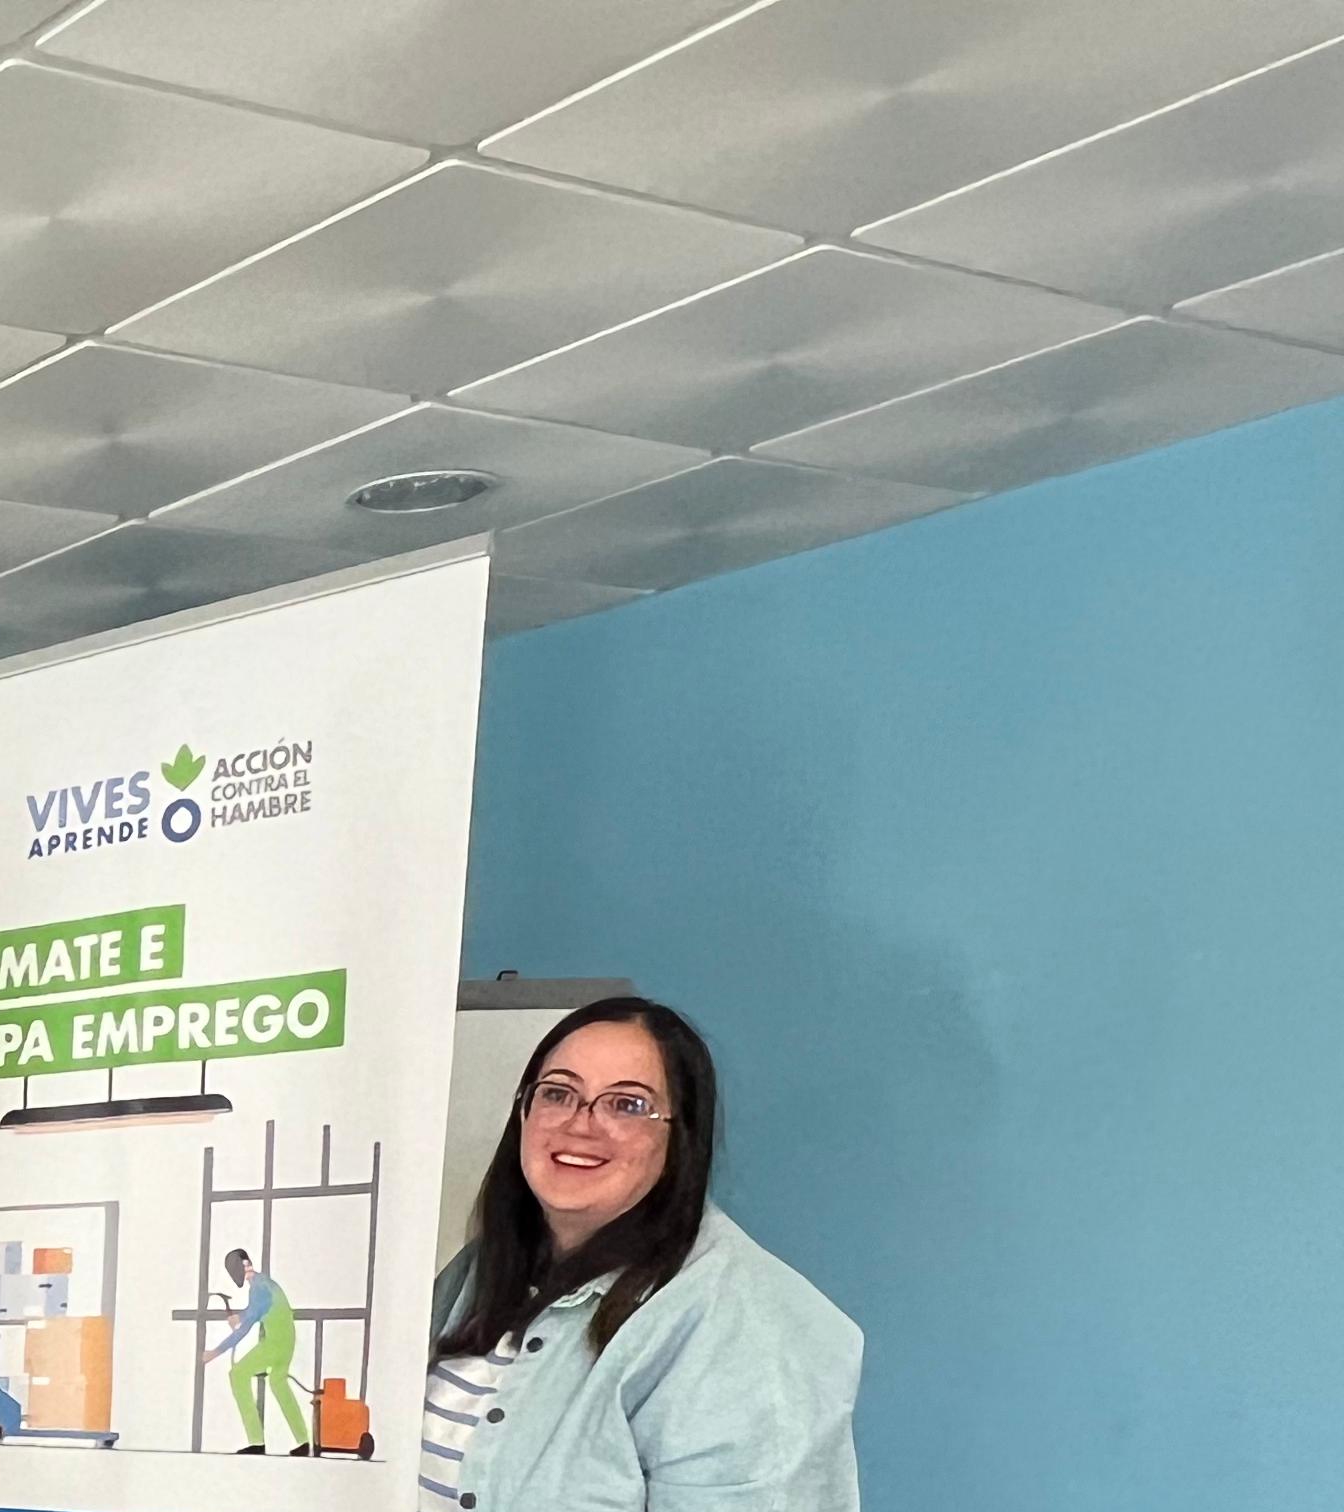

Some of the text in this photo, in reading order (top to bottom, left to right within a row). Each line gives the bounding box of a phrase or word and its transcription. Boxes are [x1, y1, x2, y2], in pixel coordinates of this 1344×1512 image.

[212, 737, 312, 781] ACCIÓN
[26, 771, 150, 832] VIVES
[211, 769, 310, 801] CONTRA EL
[211, 791, 311, 827] HAMBRE
[28, 817, 148, 859] APRENDE
[139, 924, 166, 971] E
[71, 988, 329, 1060] EMPREGO
